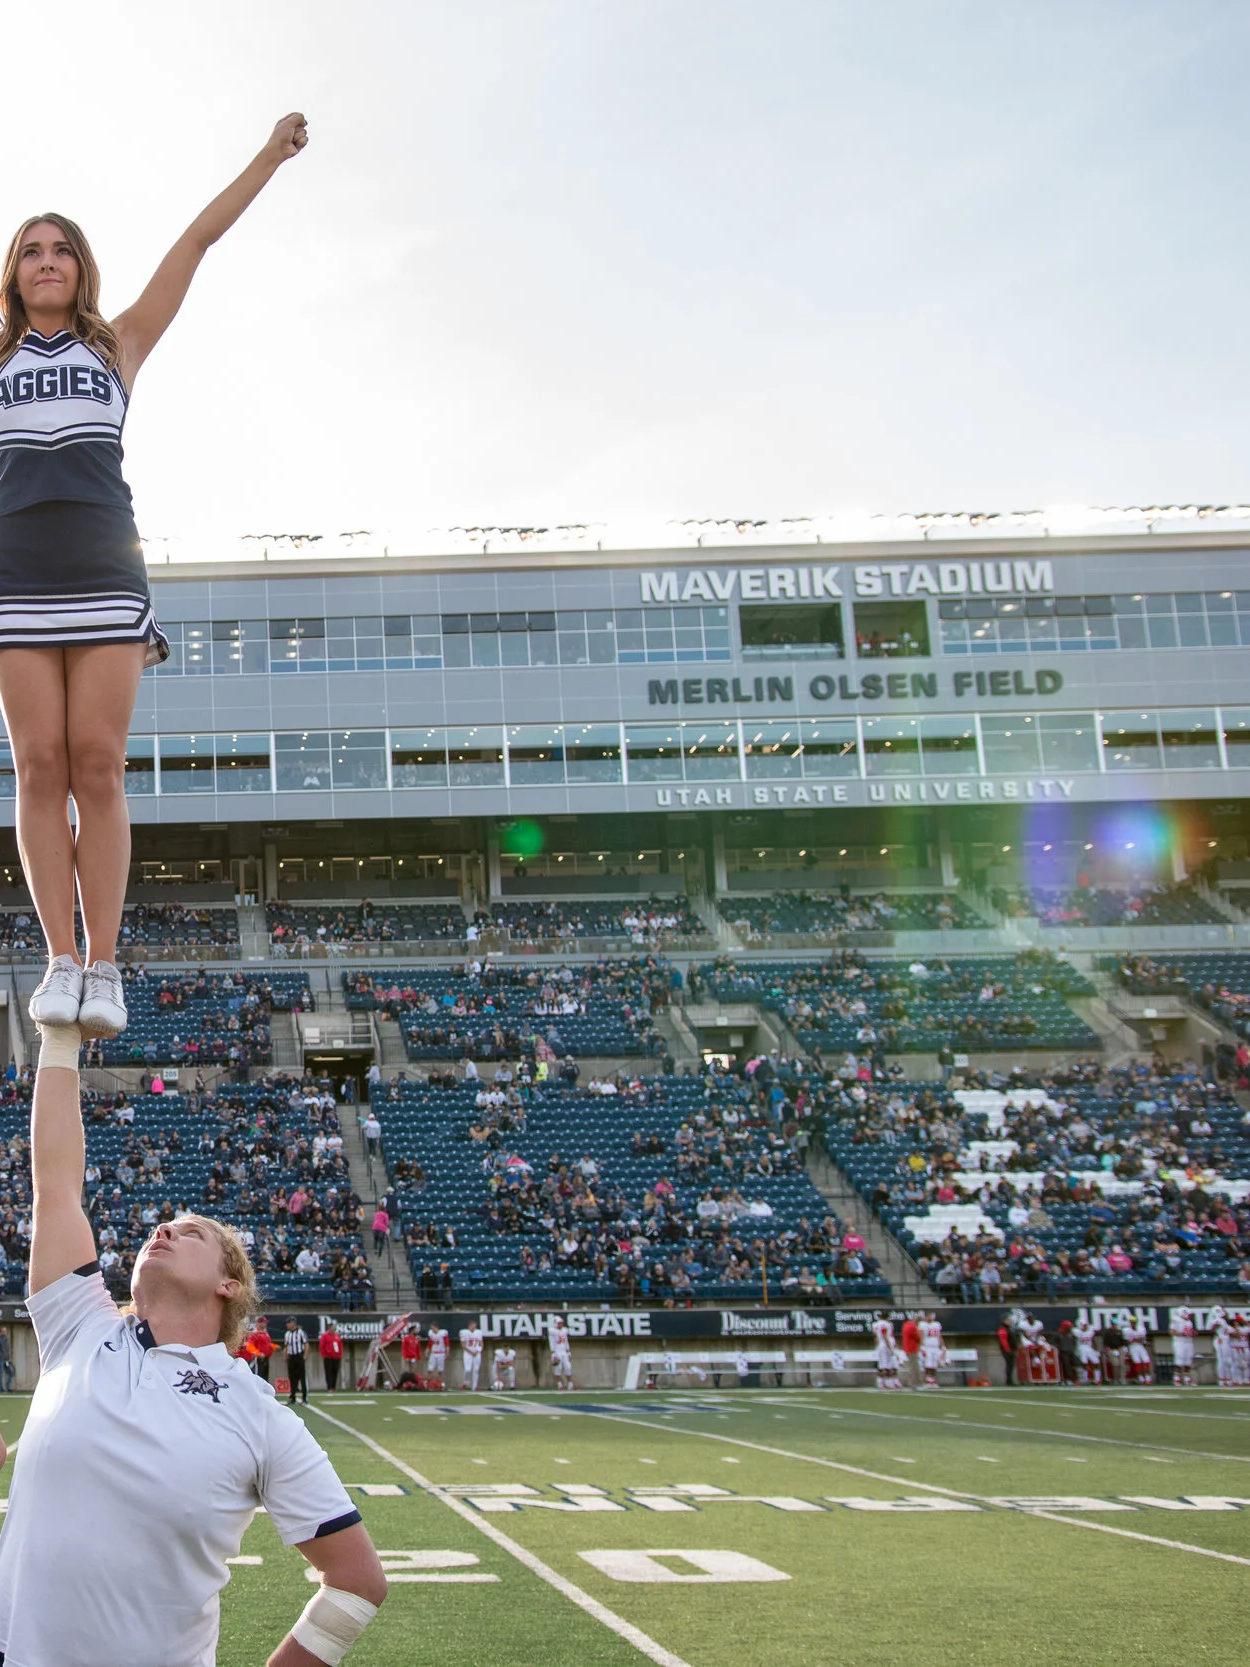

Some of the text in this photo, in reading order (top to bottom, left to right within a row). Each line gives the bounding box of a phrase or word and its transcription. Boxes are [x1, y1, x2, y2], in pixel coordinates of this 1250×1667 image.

[640, 560, 1054, 602] MAVERIK STADIUM
[648, 669, 1064, 704] MERLIN OLSEN FIELD
[656, 779, 1075, 807] UTAH STATE UNIVERSITY
[568, 1312, 652, 1336] STATE
[720, 1310, 826, 1330] Discount Tire
[835, 1310, 872, 1322] Serving
[836, 1322, 864, 1333] Since
